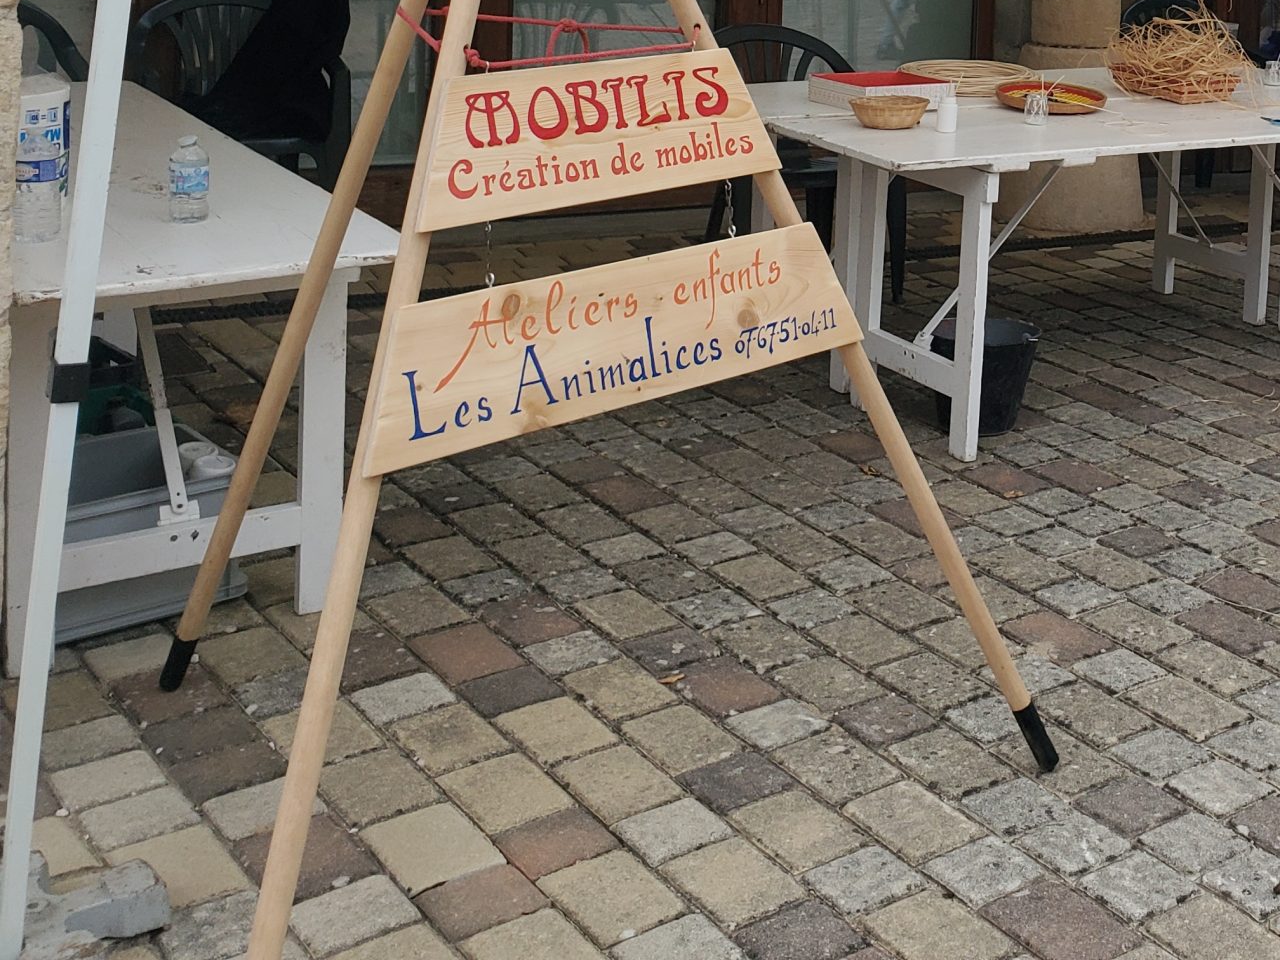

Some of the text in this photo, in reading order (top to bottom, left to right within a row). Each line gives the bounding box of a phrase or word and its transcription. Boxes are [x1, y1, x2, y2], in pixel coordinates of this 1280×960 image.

[465, 66, 729, 148] MOBILIS
[448, 122, 754, 199] Création de mobiles
[433, 248, 781, 393] Ateliers enfants
[402, 370, 492, 441] Les
[510, 316, 723, 415] Animalices
